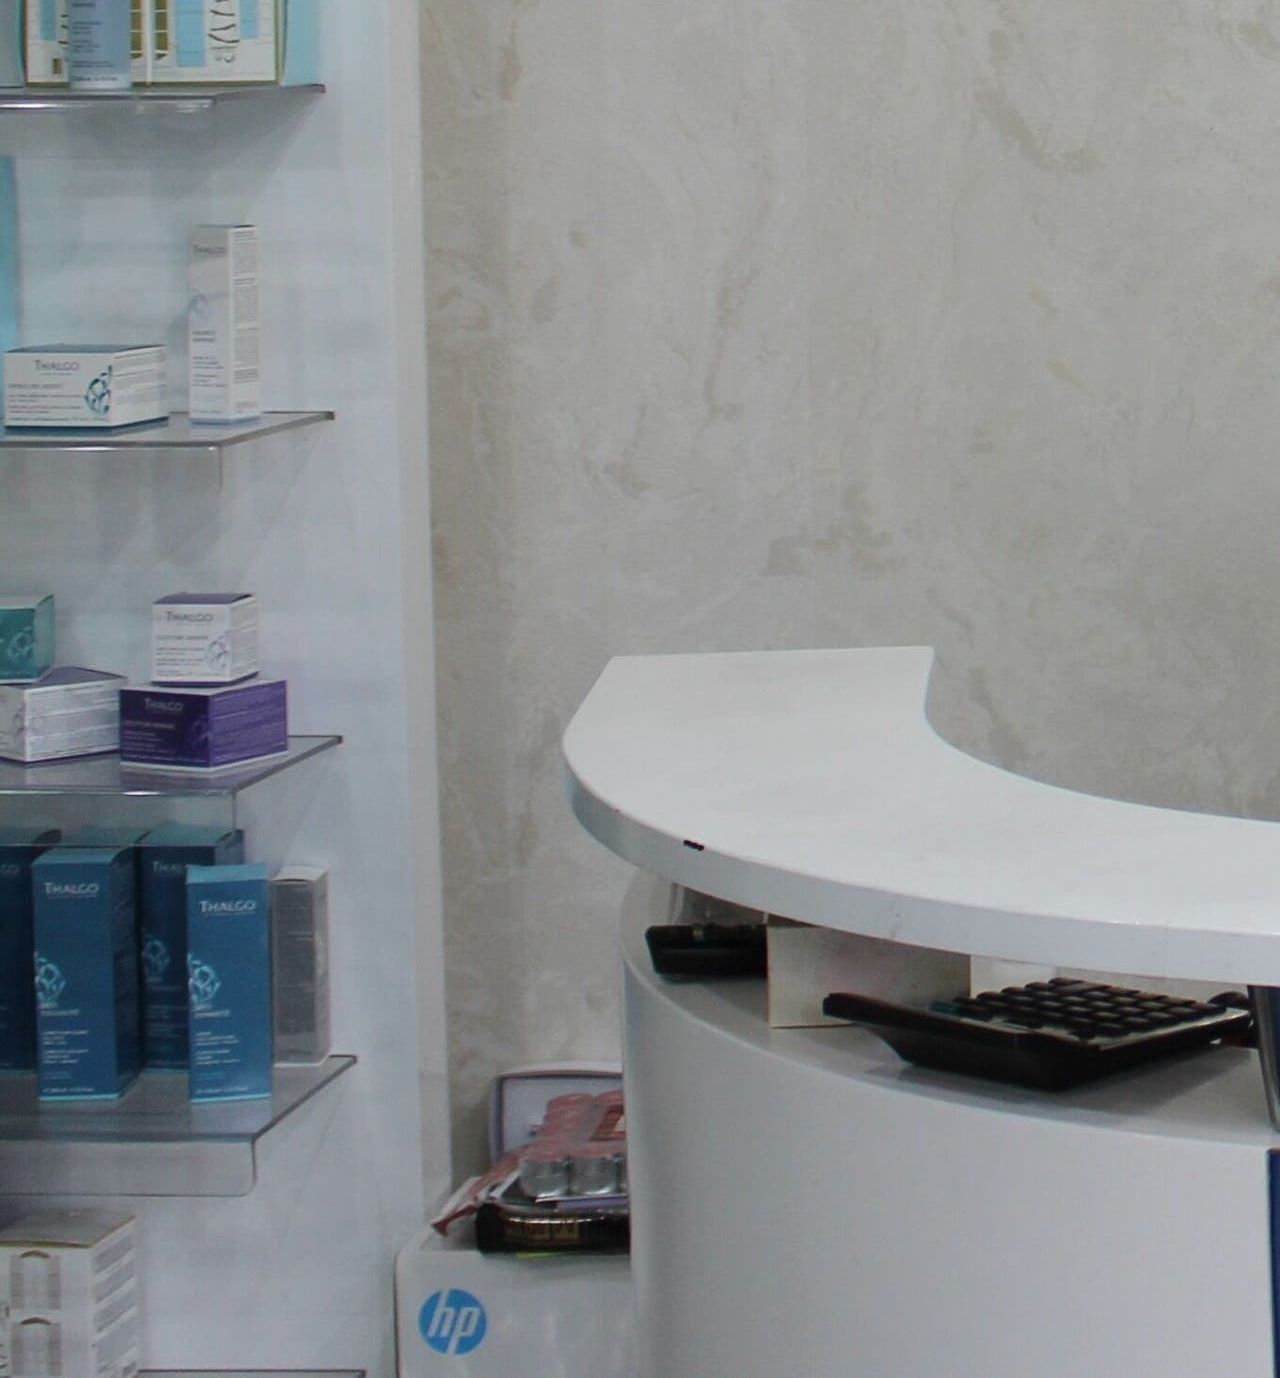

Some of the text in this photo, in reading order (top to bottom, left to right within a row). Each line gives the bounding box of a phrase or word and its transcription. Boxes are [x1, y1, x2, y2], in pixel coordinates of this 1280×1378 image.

[44, 882, 100, 895] THALGO
[198, 900, 257, 913] THALGO
[425, 1288, 482, 1355] hp
